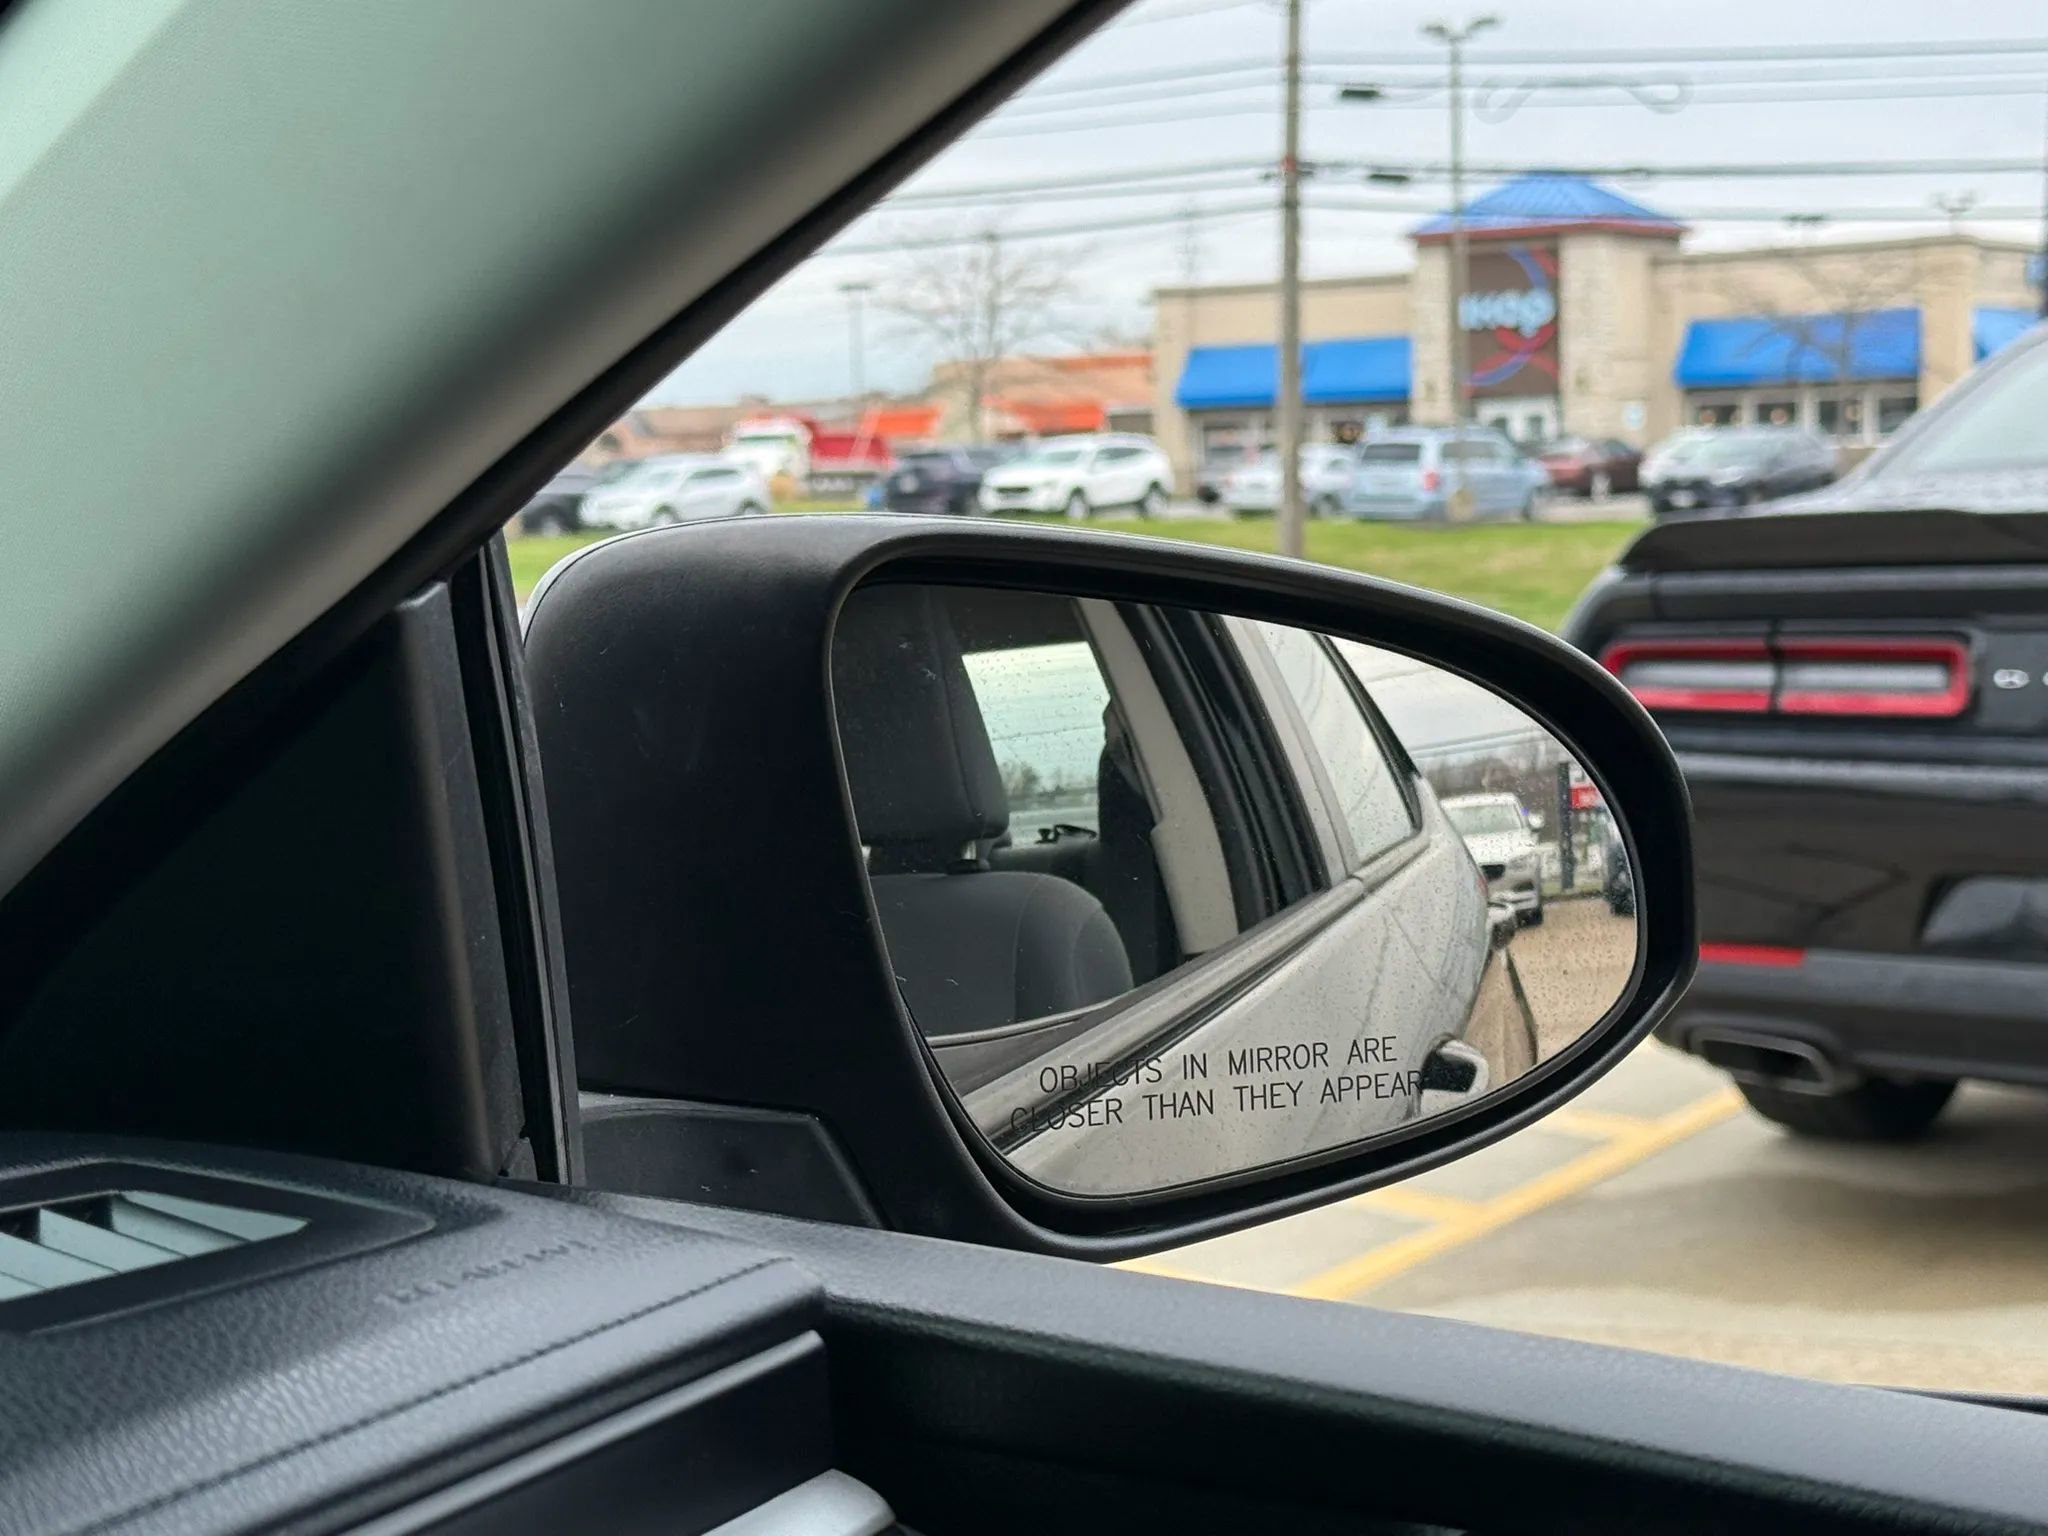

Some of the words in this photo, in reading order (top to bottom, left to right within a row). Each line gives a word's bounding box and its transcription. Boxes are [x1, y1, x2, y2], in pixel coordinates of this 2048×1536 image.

[1040, 1057, 1162, 1093] OBJECTS
[1183, 1053, 1207, 1080] IN
[1228, 1042, 1328, 1076] MIRROR
[1347, 1036, 1398, 1065] ARE
[1010, 1097, 1123, 1132] CLOSER
[1142, 1089, 1214, 1121] THAN
[1233, 1080, 1303, 1112] THEY
[1320, 1070, 1423, 1104] APPEAR
